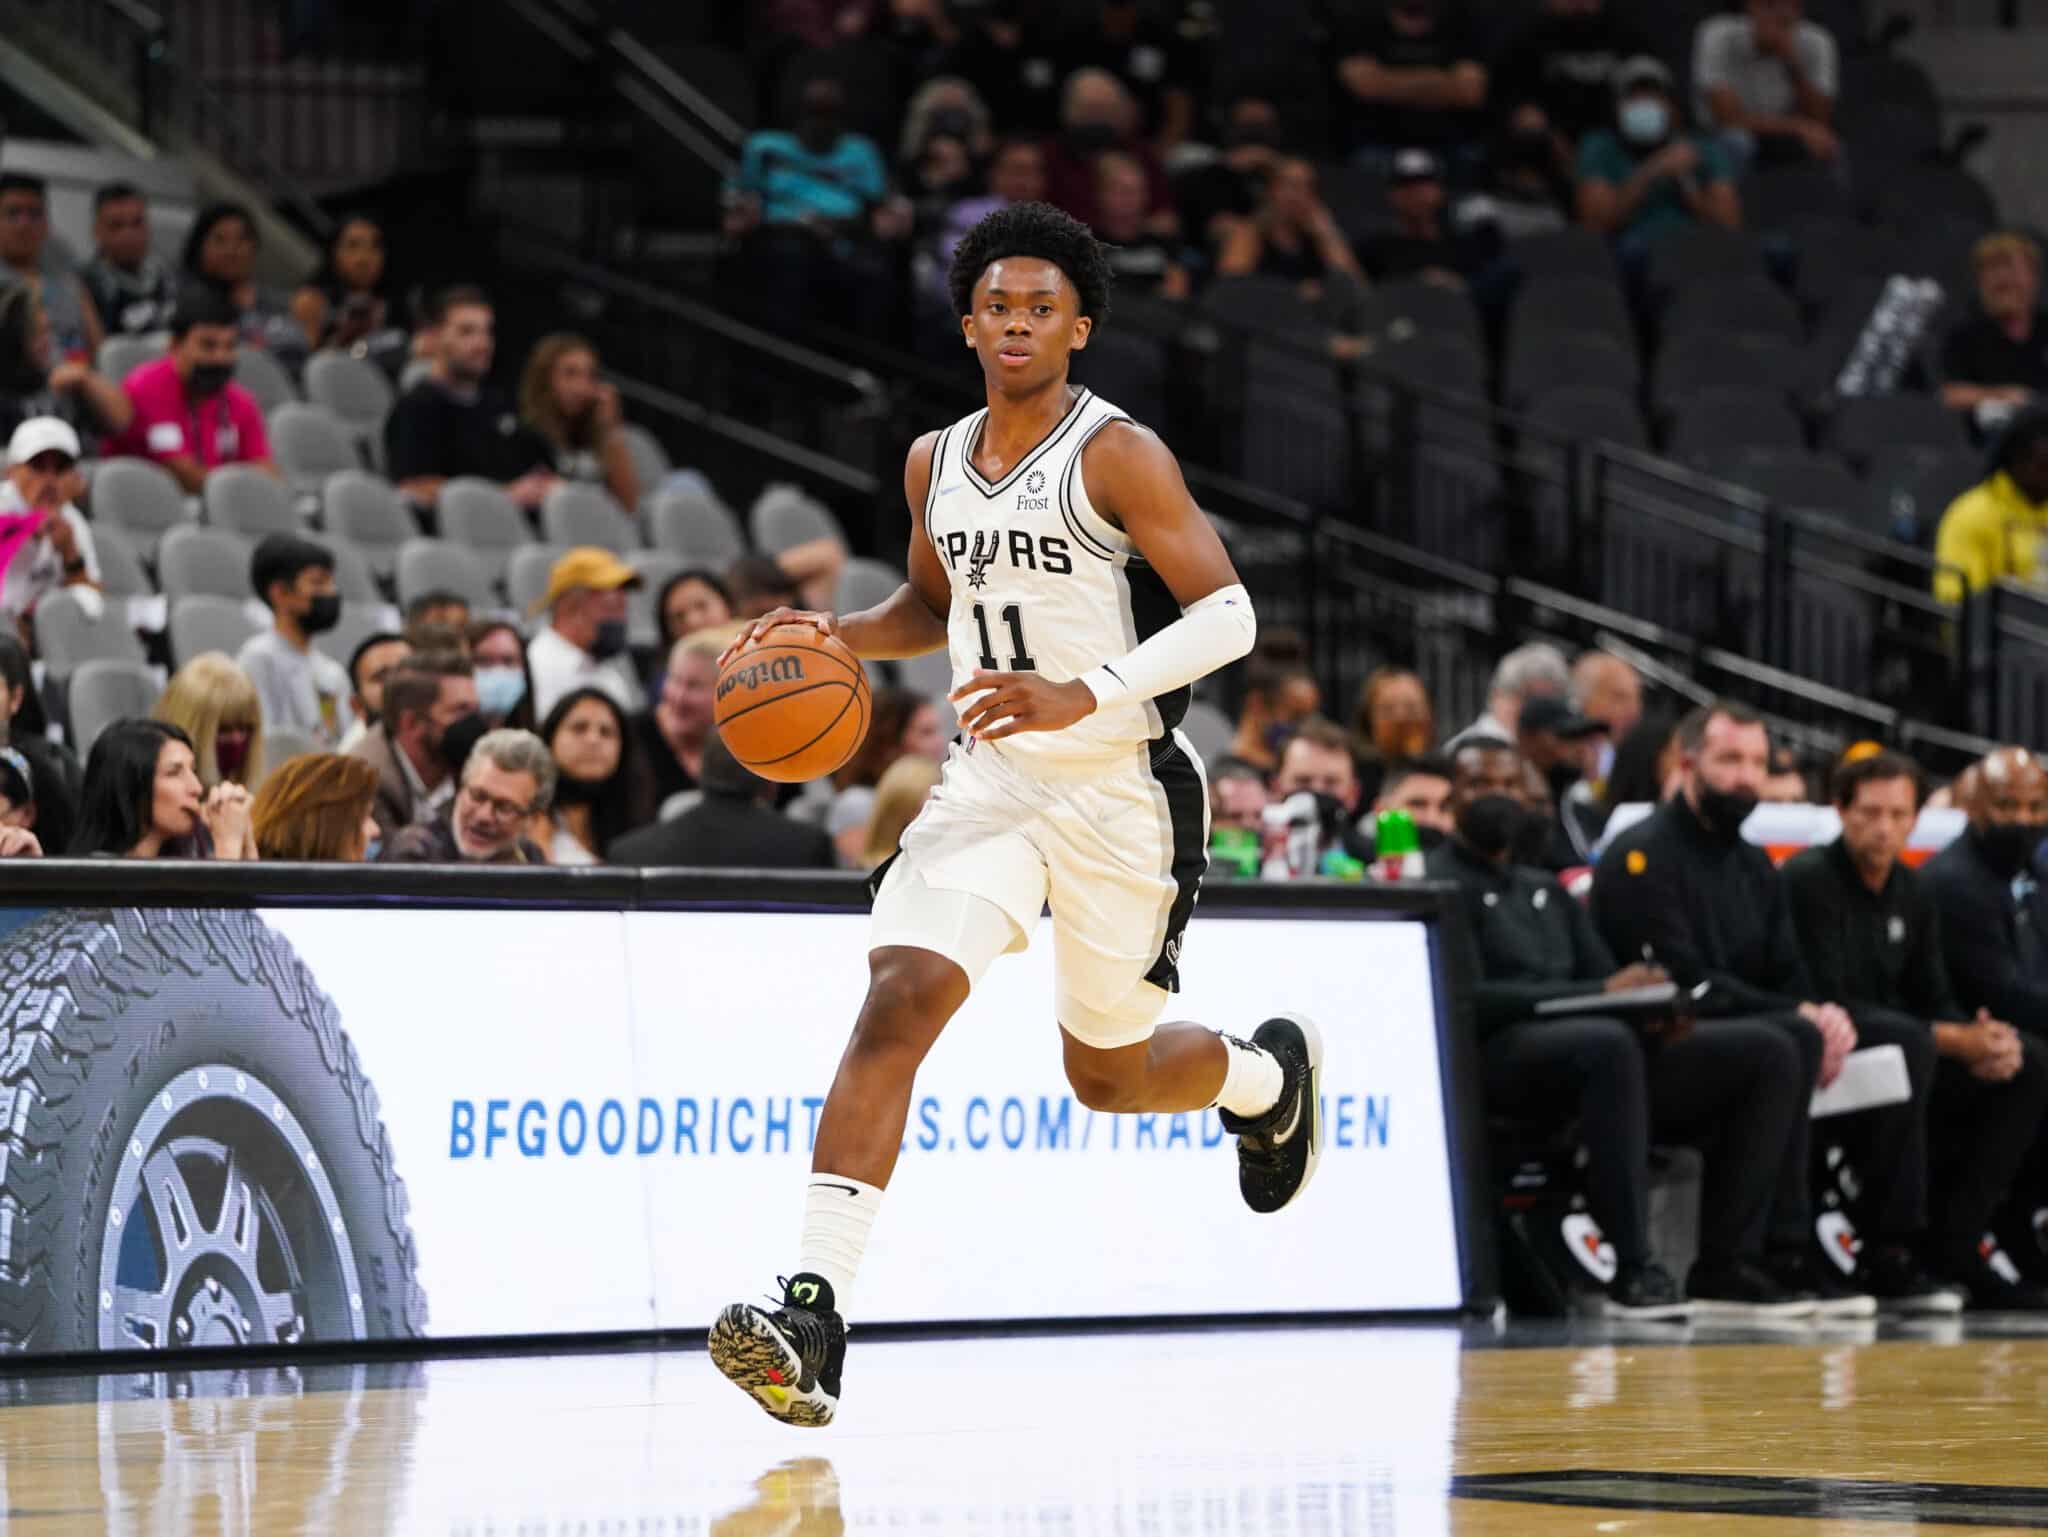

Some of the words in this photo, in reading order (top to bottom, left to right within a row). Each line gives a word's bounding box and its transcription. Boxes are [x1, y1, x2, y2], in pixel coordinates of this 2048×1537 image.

[1016, 495, 1049, 511] Frost
[970, 600, 1039, 672] 11
[716, 655, 805, 702] Wilson
[449, 1095, 1391, 1159] BFGOODRICHTS.COM/RADEN
